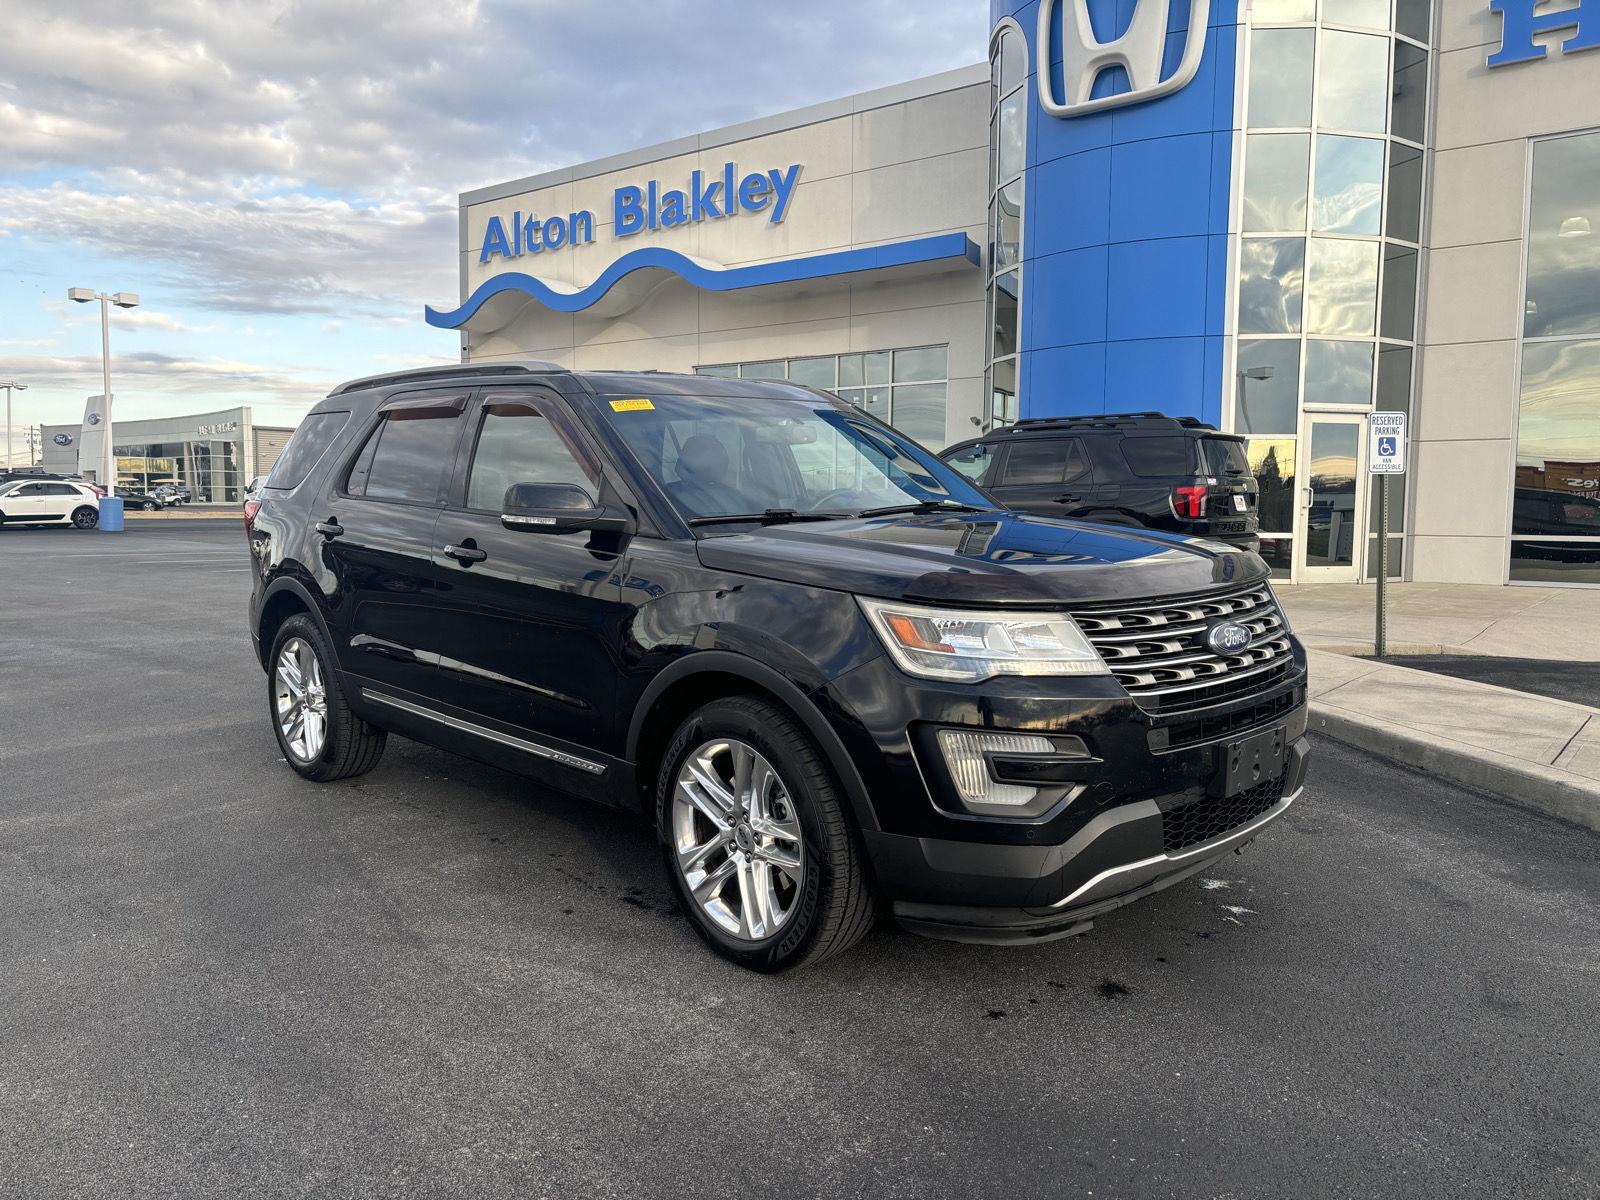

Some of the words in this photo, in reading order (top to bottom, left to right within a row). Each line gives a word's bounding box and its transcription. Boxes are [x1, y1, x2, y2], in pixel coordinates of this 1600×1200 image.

[479, 208, 595, 263] Alton
[613, 161, 804, 238] Blakley
[1371, 416, 1404, 426] RESERVED
[1374, 427, 1400, 436] PARKING
[1223, 626, 1246, 648] Ford
[782, 866, 818, 953] GOODYEAR
